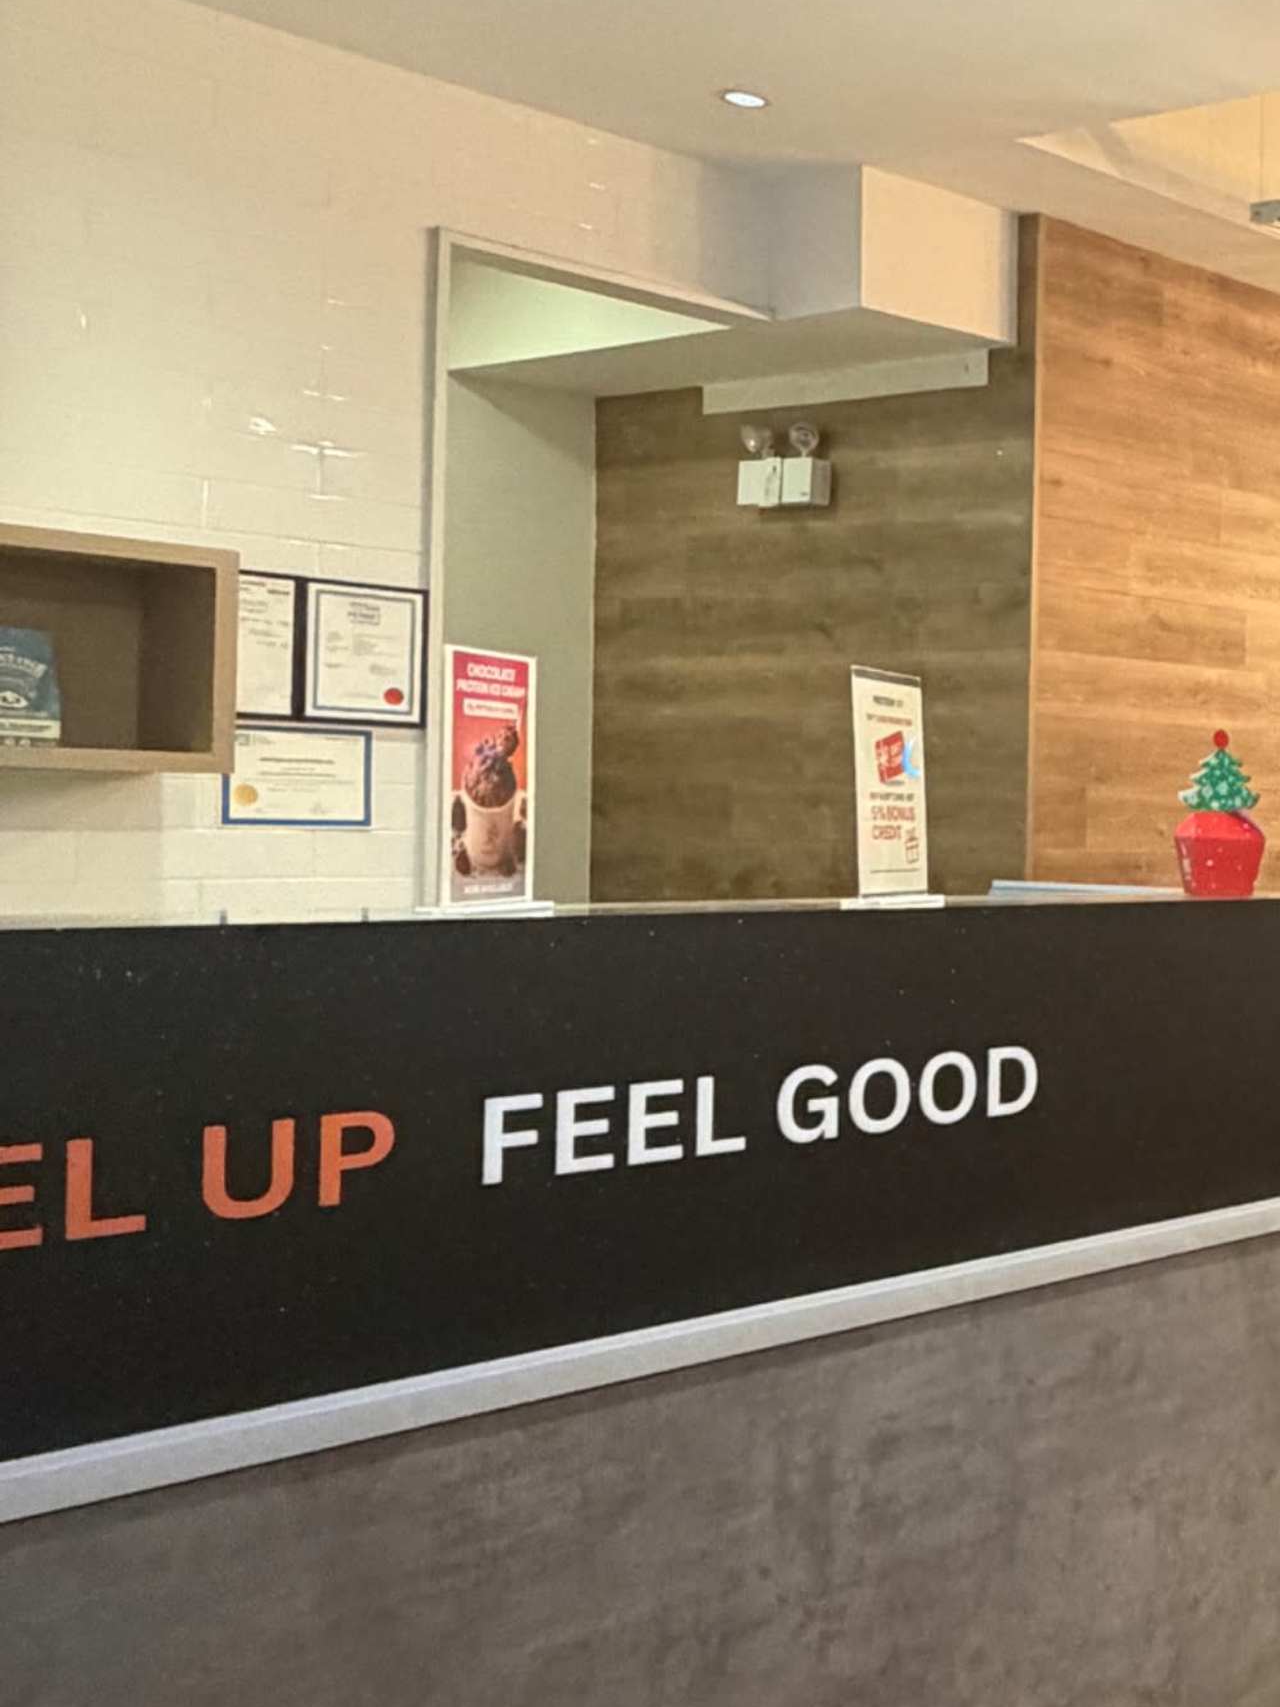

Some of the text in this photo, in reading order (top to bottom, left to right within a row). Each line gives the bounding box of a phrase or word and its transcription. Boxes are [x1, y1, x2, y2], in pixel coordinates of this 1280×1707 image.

[202, 1113, 396, 1220] UP
[482, 1075, 746, 1186] FEEL
[776, 1045, 1039, 1144] GOOD
